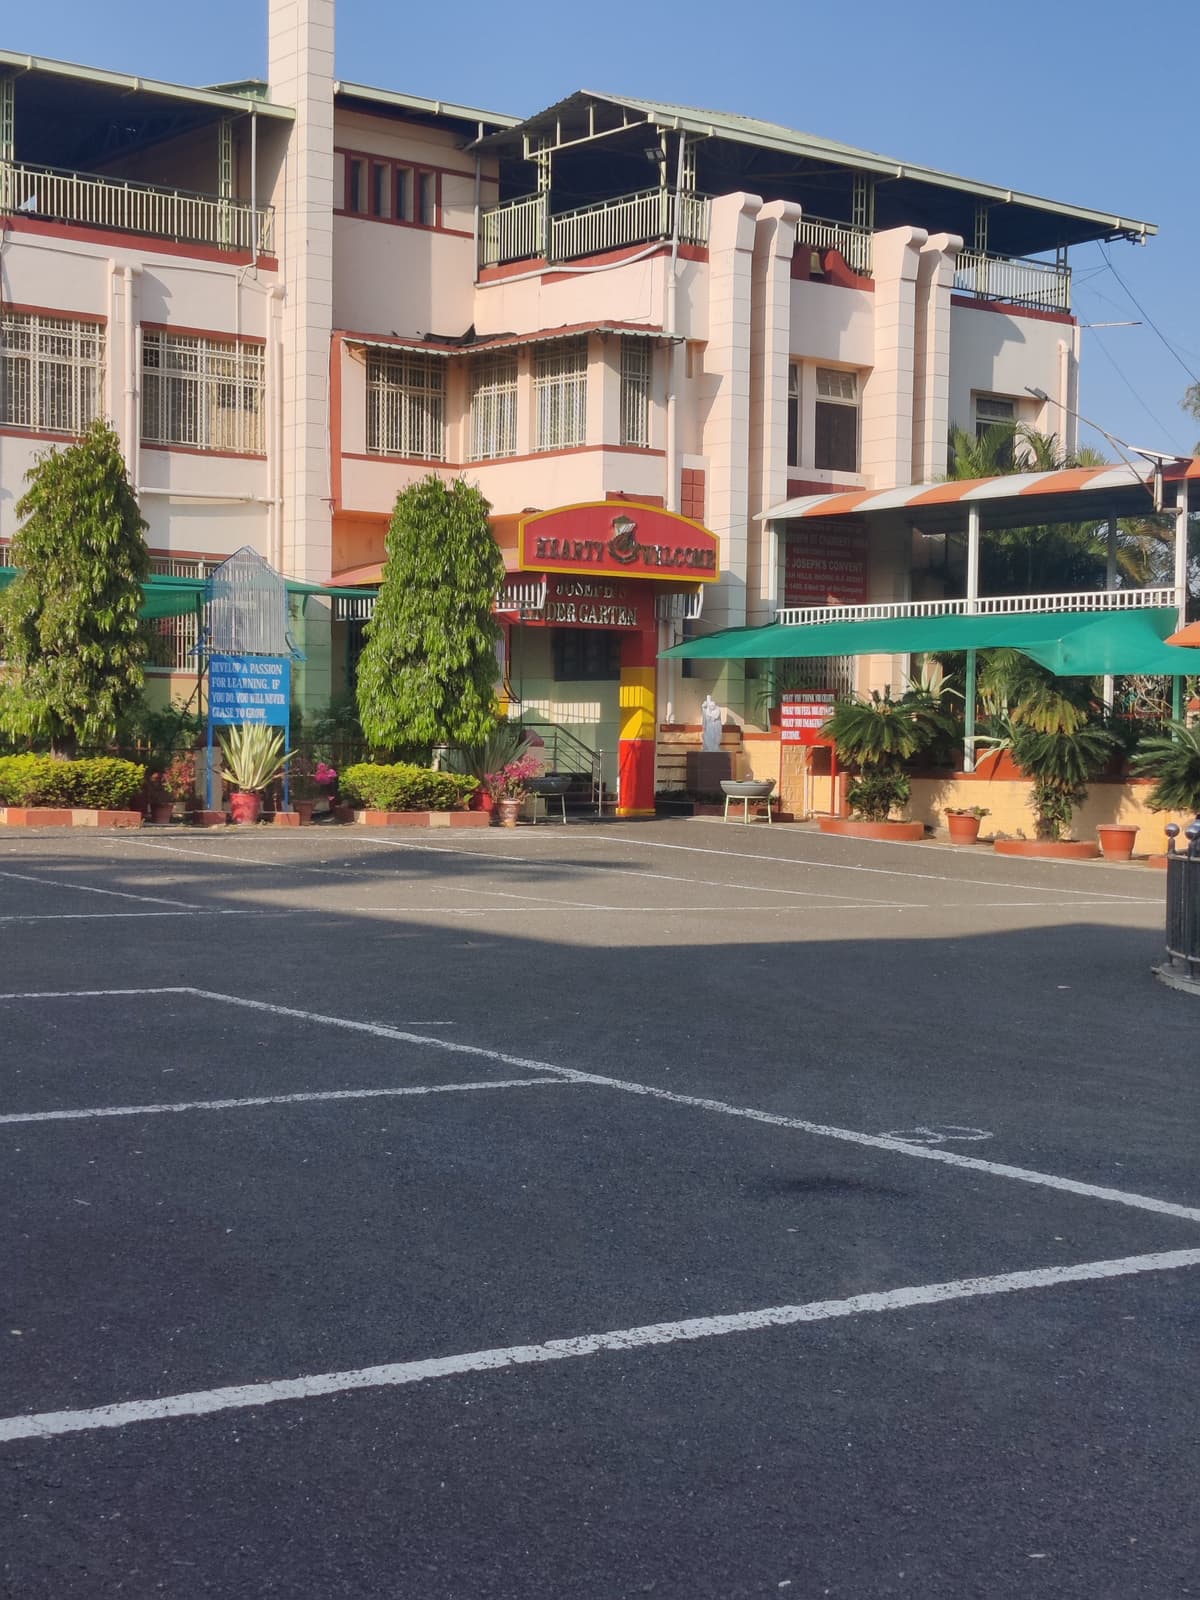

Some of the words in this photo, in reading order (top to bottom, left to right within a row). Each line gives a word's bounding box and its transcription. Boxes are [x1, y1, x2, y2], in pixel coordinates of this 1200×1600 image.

[536, 537, 604, 562] HEARTY
[637, 544, 714, 570] WELCOME
[579, 603, 638, 626] GARTEN
[211, 661, 241, 673] DEVELOP
[242, 664, 248, 674] A
[250, 663, 282, 675] PASSION
[211, 677, 226, 688] FOR
[271, 679, 280, 690] IF
[211, 692, 225, 703] YOU
[236, 692, 248, 704] YOU
[249, 693, 264, 704] WILL
[264, 693, 285, 704] NEVER
[235, 708, 245, 718] TO
